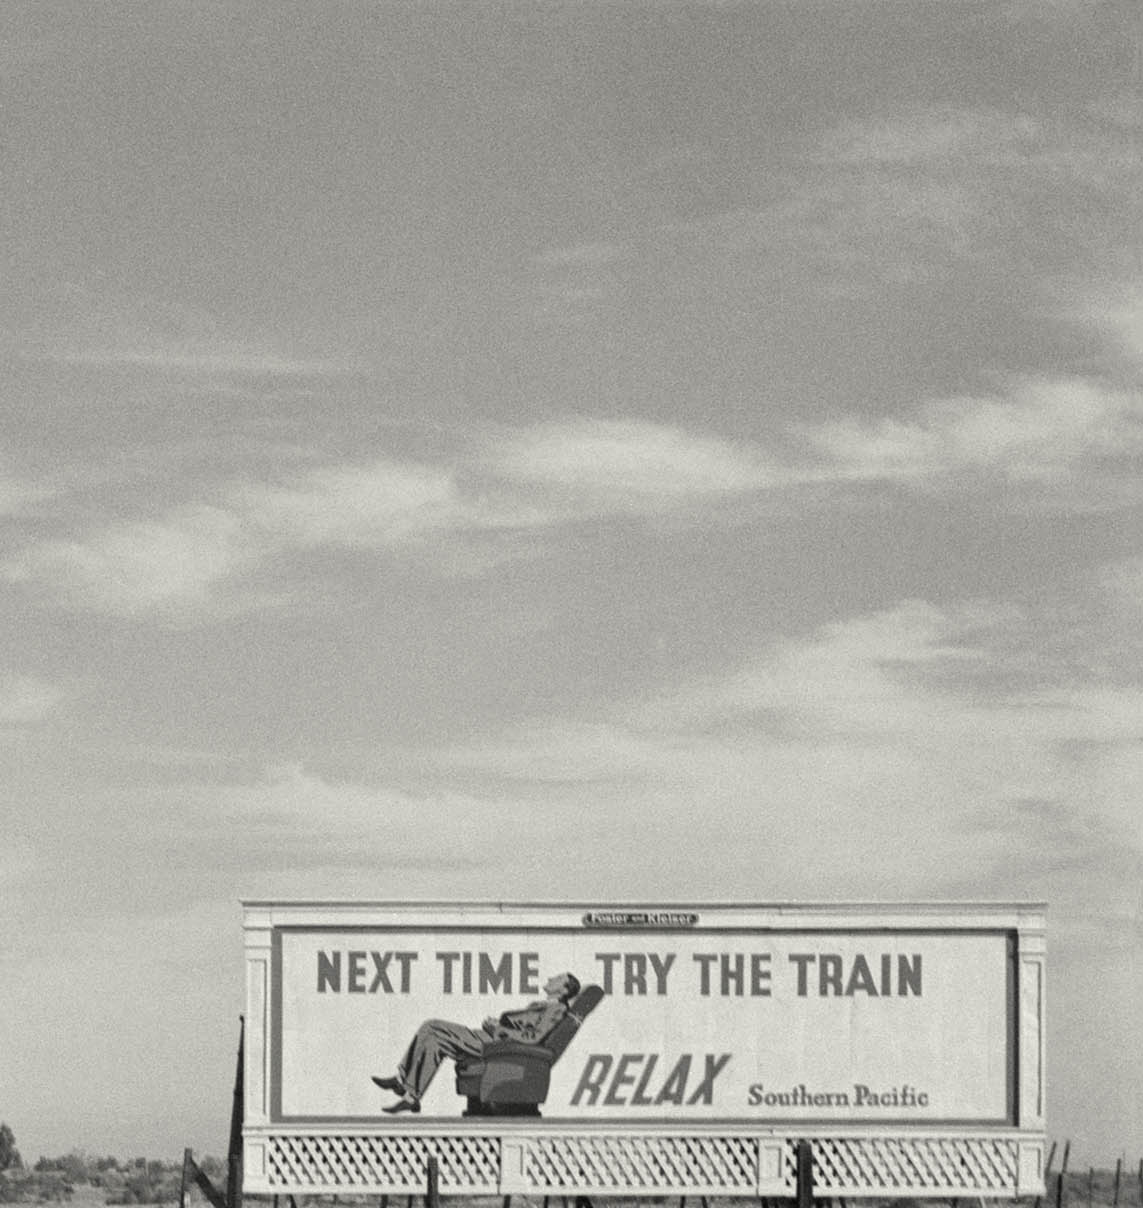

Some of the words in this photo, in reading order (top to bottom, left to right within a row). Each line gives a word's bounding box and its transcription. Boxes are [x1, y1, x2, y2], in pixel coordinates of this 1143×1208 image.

[317, 950, 418, 994] NEXT
[436, 951, 539, 995] TIME
[595, 952, 676, 996] TRY
[692, 953, 772, 997] THE
[788, 953, 923, 997] TRAIN
[570, 1053, 732, 1107] RELAX
[747, 1083, 849, 1107] Southern
[854, 1083, 929, 1107] Pacific
